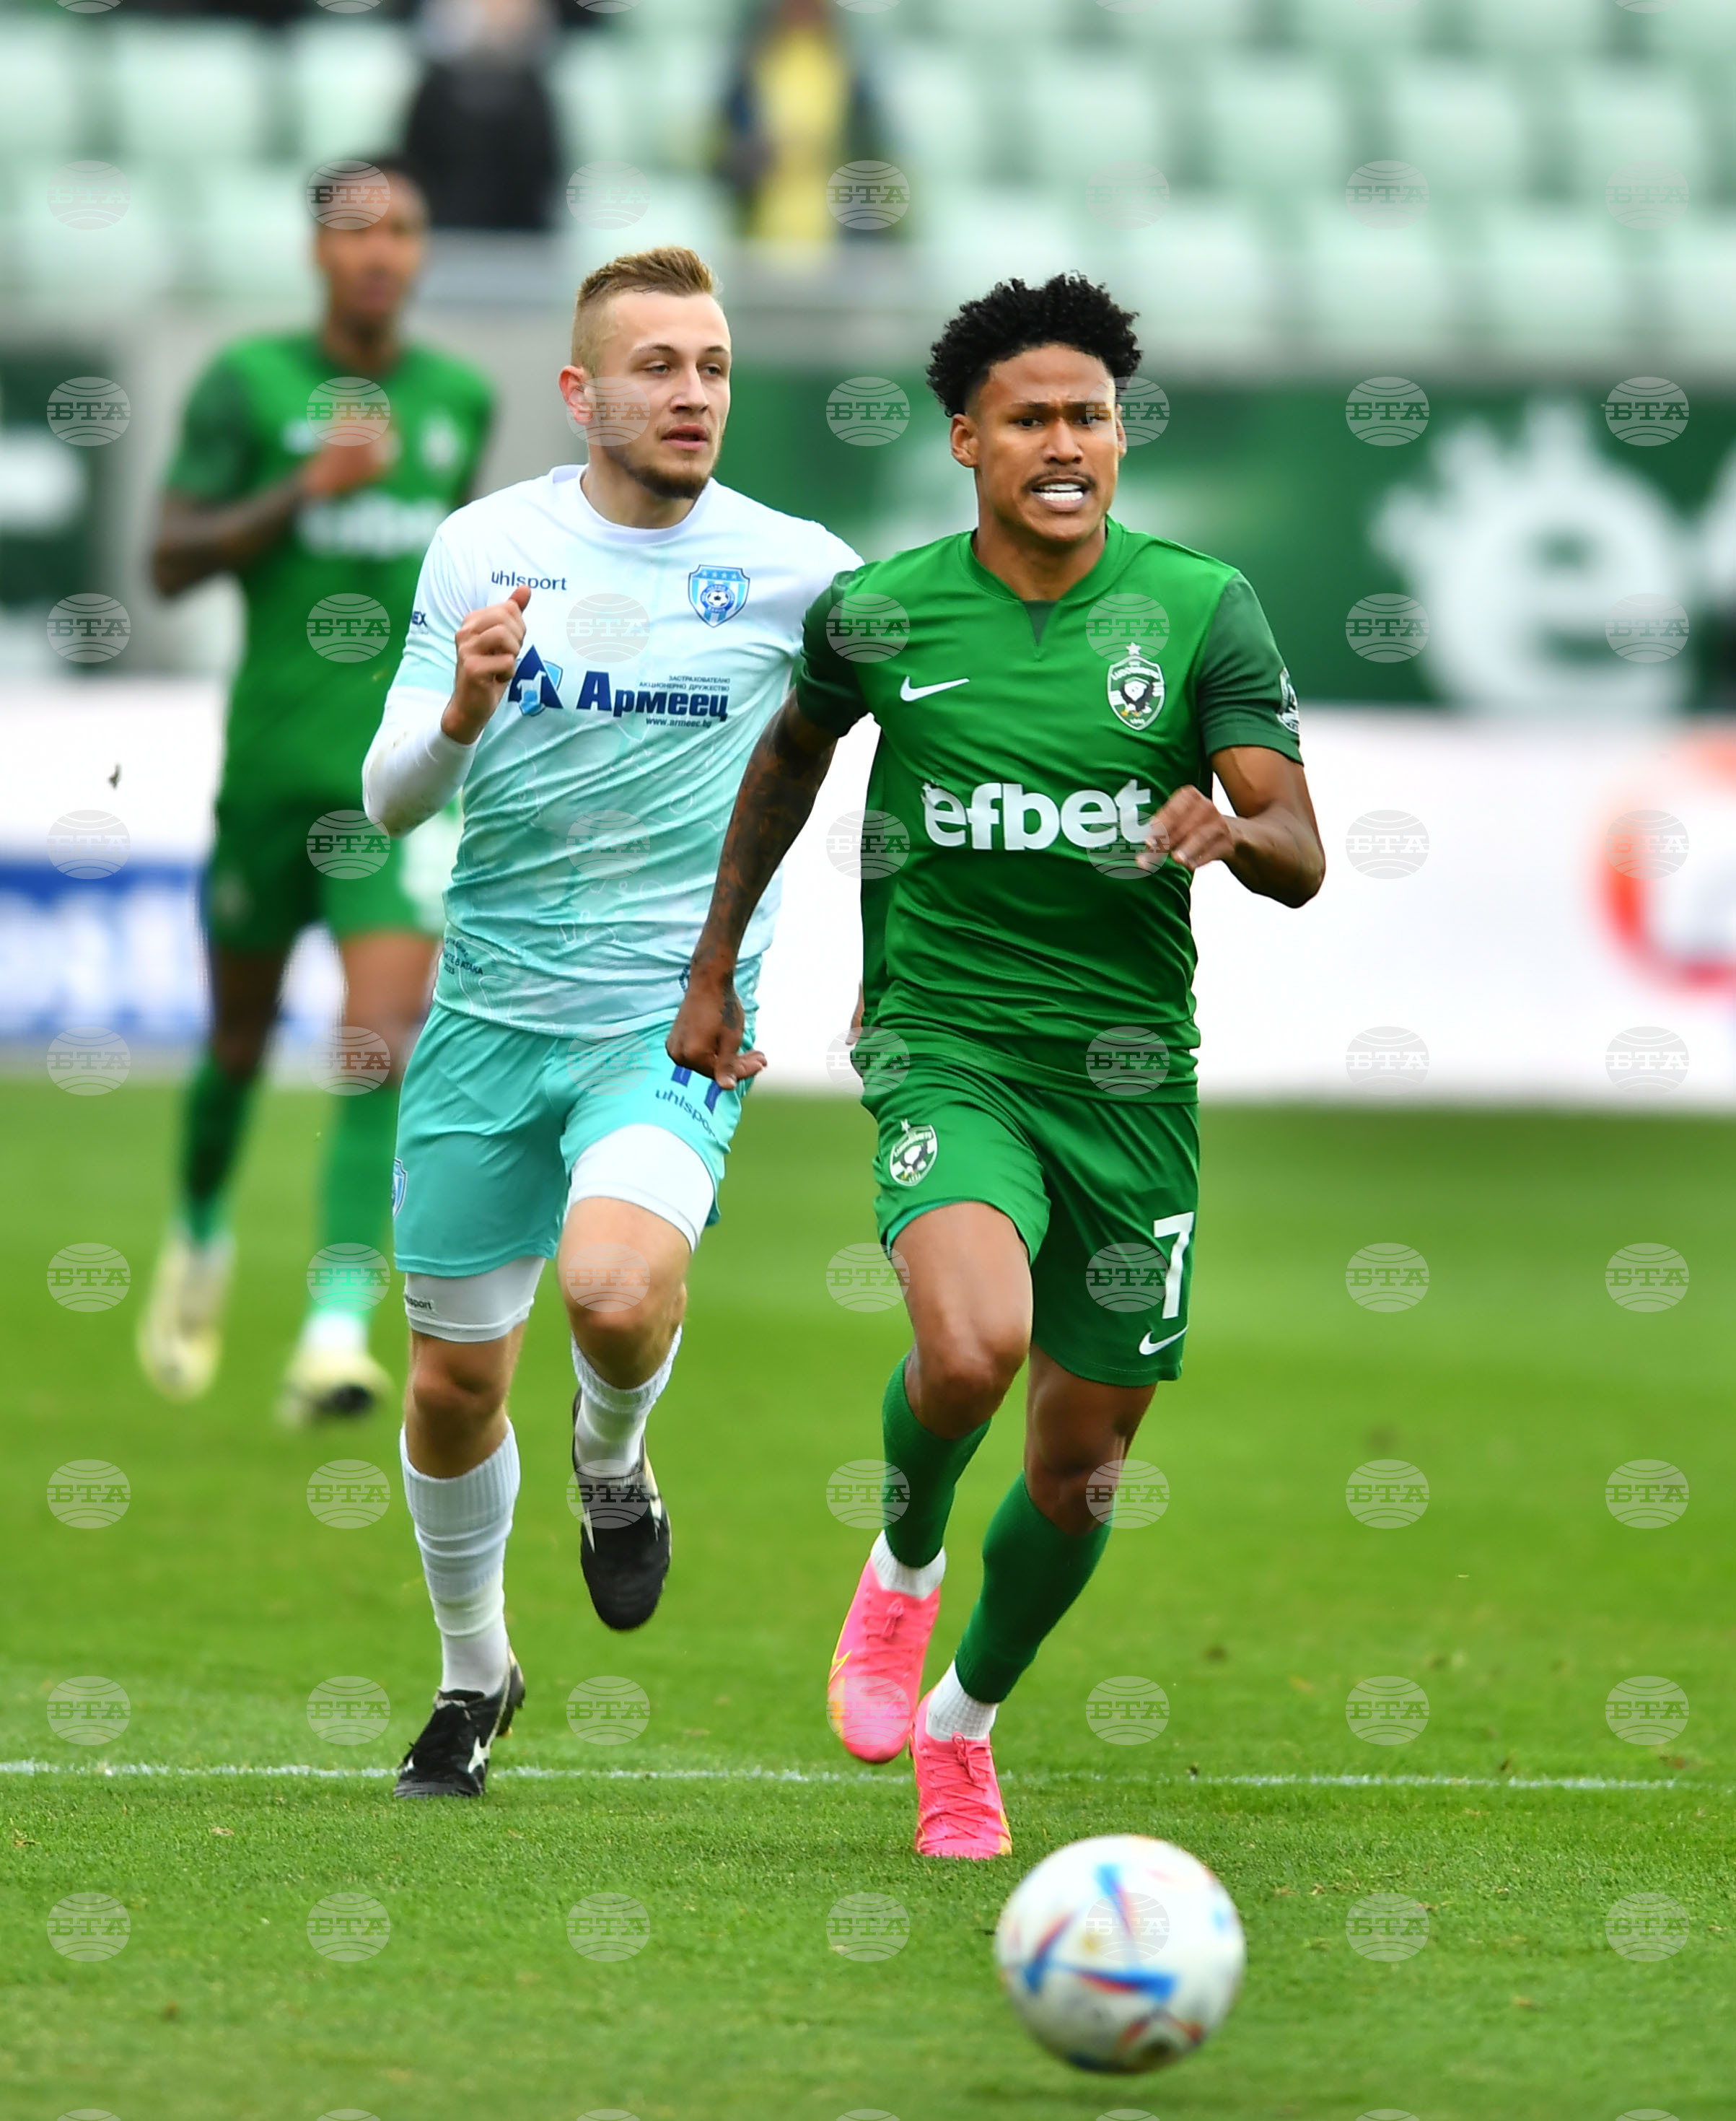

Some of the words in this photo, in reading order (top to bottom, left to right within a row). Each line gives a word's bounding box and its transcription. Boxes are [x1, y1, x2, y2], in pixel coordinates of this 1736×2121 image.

[491, 570, 567, 591] uhlsport
[576, 670, 729, 722] Армеец
[639, 681, 687, 690] АКЦИОНЕРНО
[688, 683, 730, 692] ДРУЖЕСТВО
[668, 675, 730, 684] ЗАСТРАХОВАТЕЛНО
[646, 717, 712, 729] www.armeec.bg
[921, 779, 1153, 852] efbet
[655, 1088, 719, 1140] uhlspor
[1153, 1211, 1195, 1320] 7
